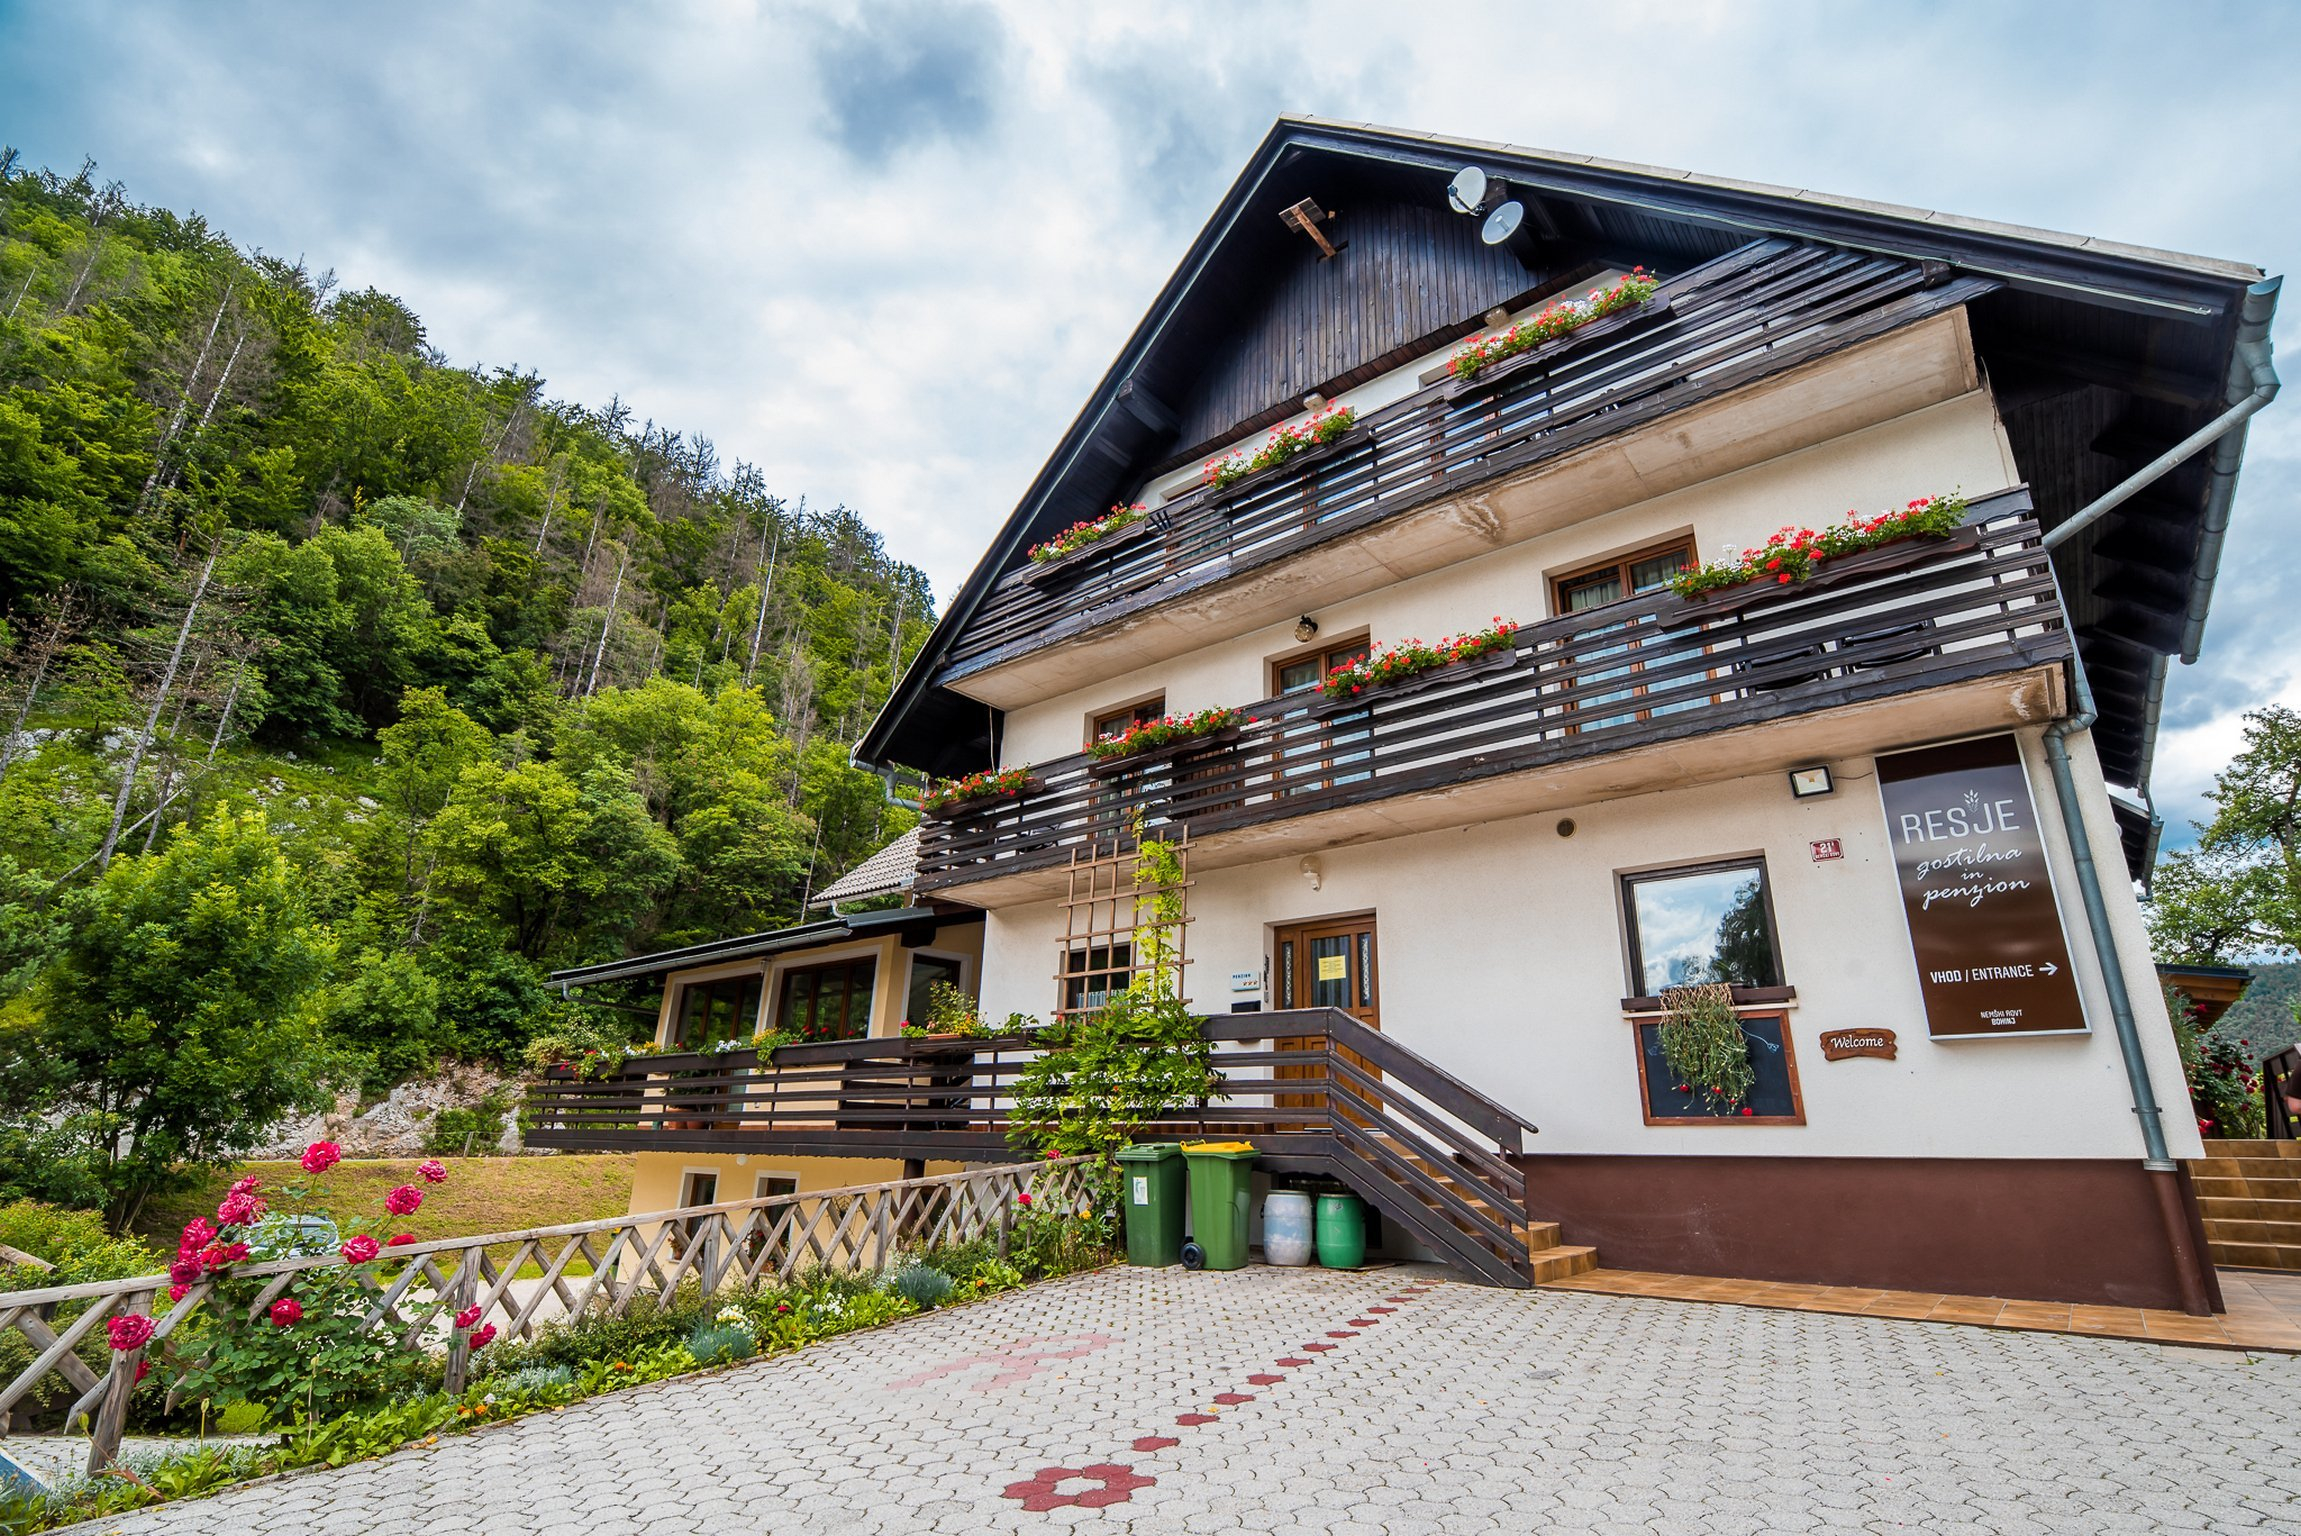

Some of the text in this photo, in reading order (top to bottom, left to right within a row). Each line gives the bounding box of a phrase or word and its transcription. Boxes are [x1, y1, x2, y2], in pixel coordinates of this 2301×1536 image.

[1899, 799, 2020, 844] RESJE
[1916, 843, 2022, 880] gostilna
[1961, 868, 1984, 880] in
[1922, 876, 2030, 910] penzion
[1930, 969, 1962, 984] VHOD
[1972, 964, 2034, 981] ENTRANCE
[1830, 1034, 1884, 1049] Welcome
